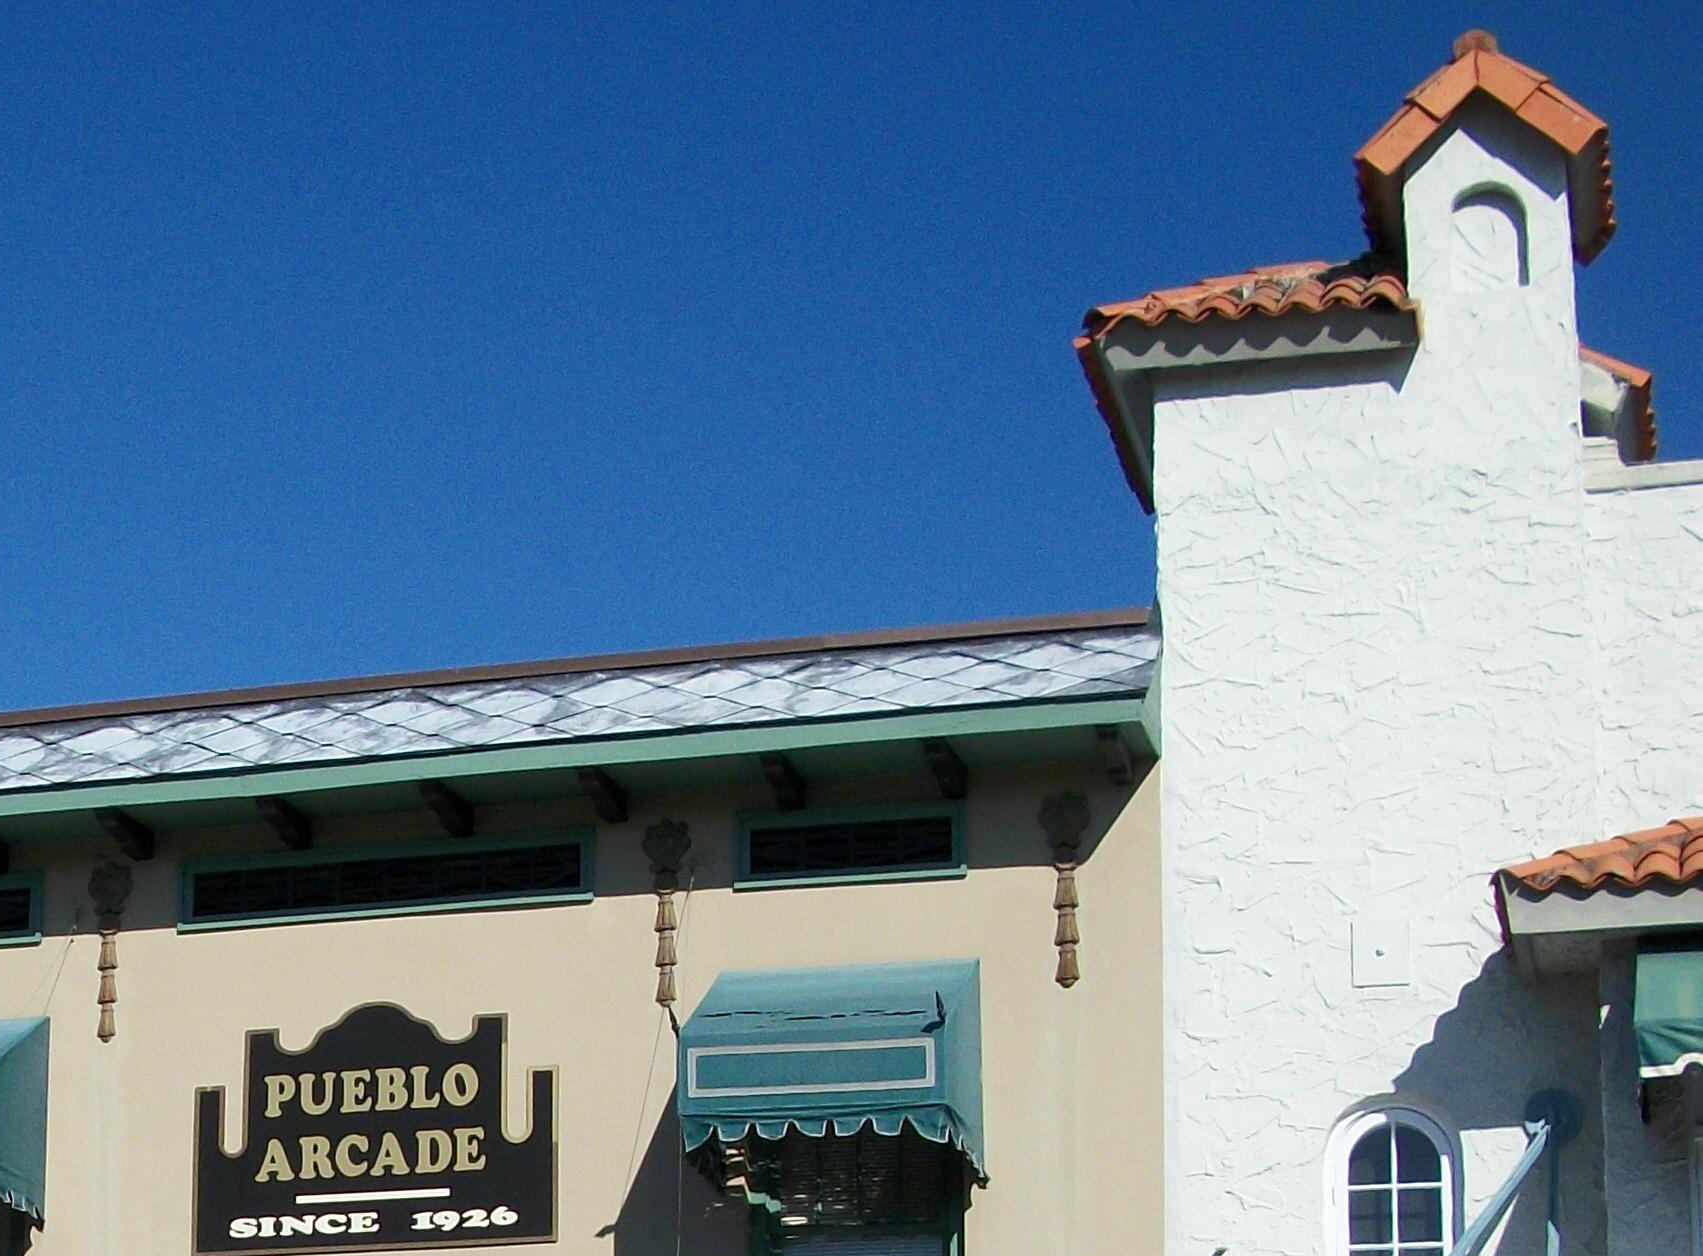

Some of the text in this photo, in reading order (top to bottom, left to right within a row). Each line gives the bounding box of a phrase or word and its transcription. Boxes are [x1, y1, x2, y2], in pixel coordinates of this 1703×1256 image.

[264, 1063, 479, 1117] PUEBLO
[254, 1127, 486, 1182] ARCADE
[229, 1206, 519, 1238] SINCE 1926
